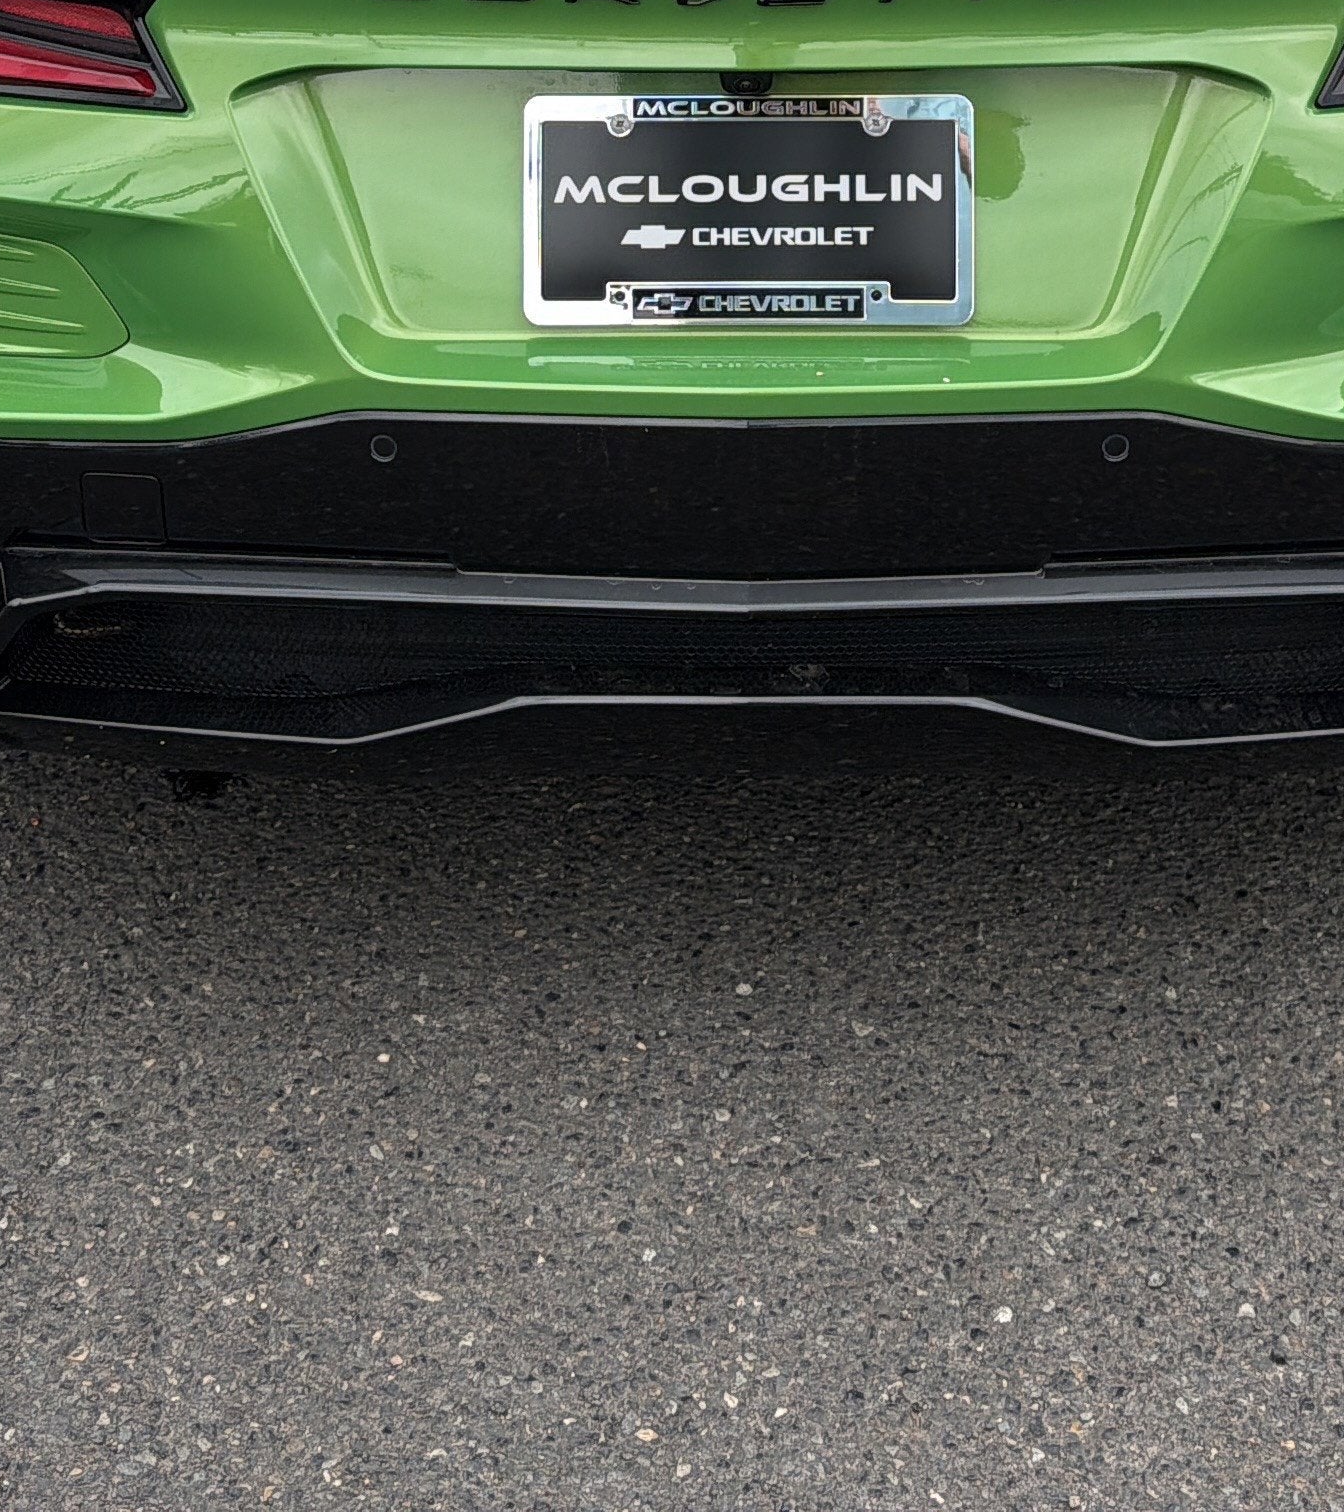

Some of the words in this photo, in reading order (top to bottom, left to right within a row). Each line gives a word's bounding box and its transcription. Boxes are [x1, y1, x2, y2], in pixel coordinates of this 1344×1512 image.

[637, 99, 862, 116] MCLOUGHLIN
[553, 173, 943, 204] MCLOUGHLIN
[692, 227, 875, 246] CHEVROLET
[698, 294, 861, 313] CHEVROLET
